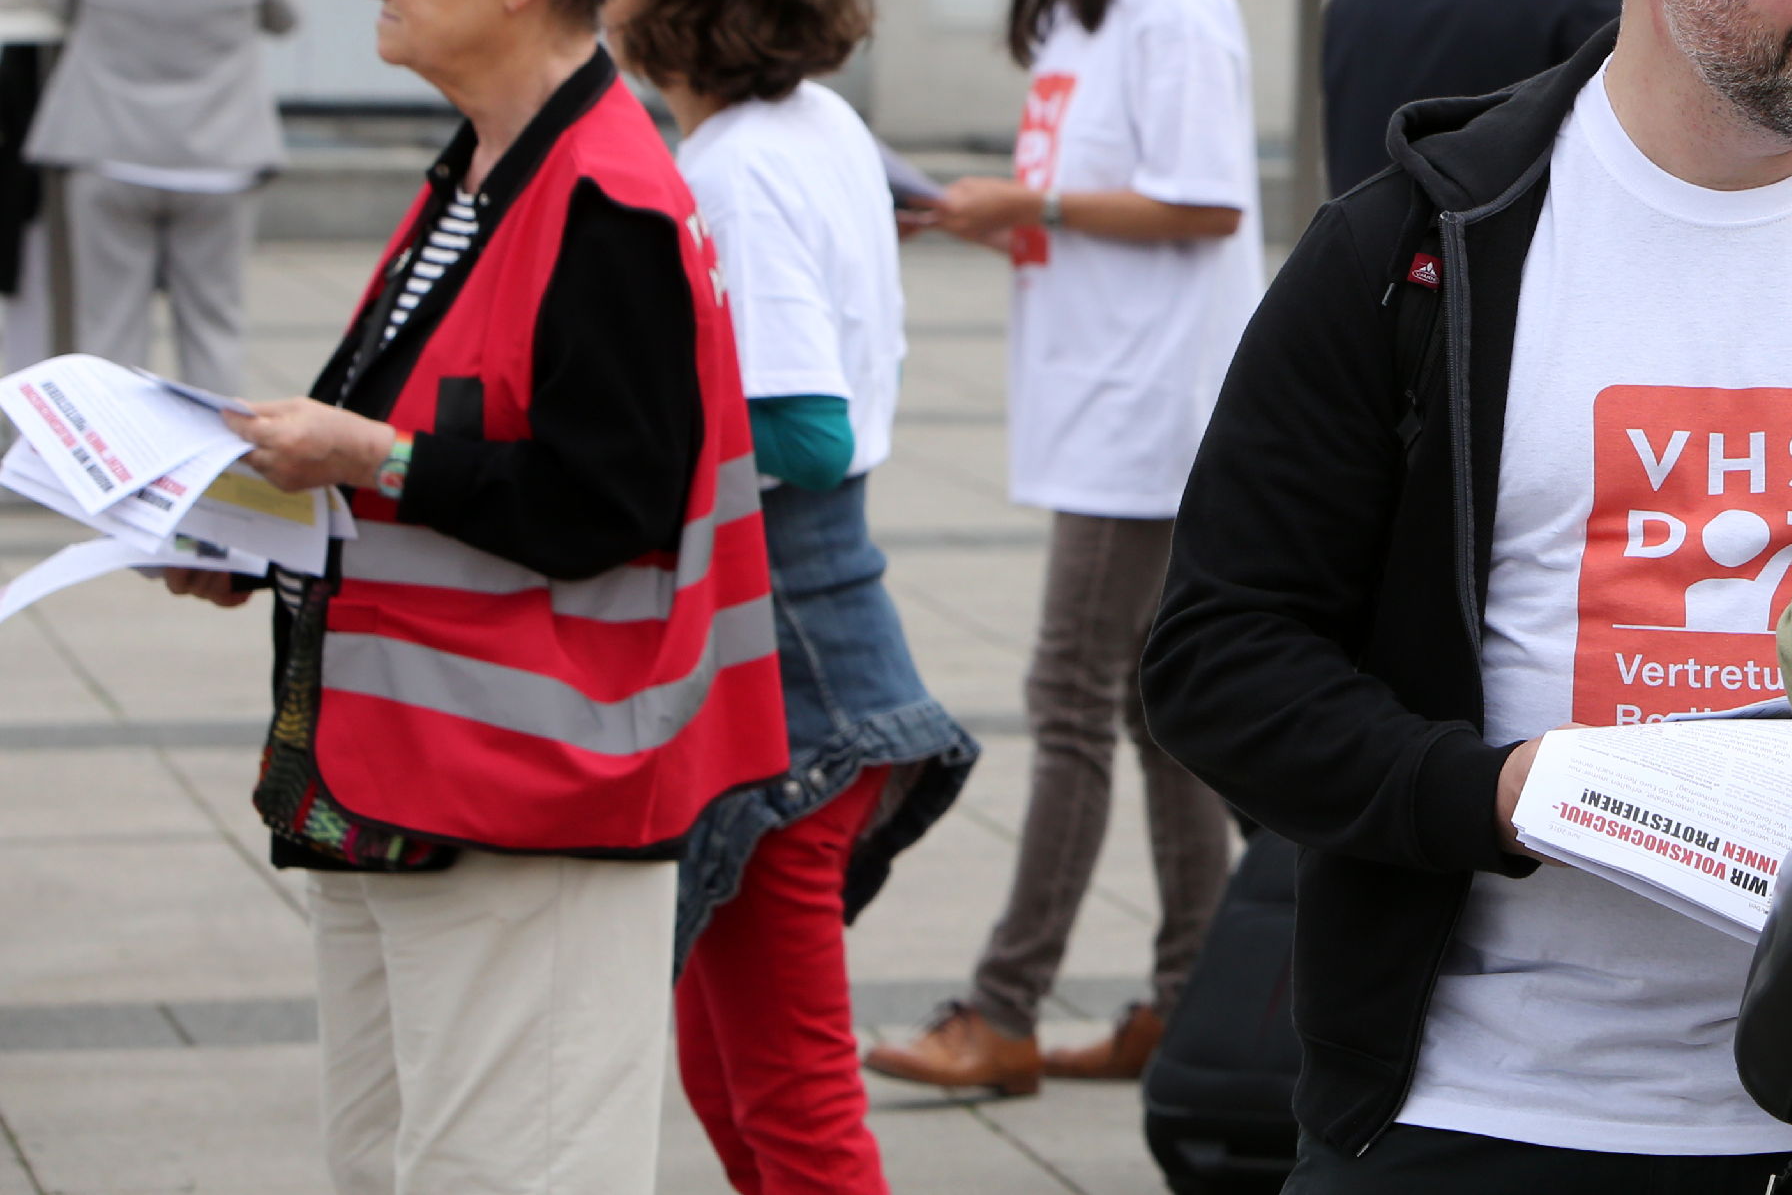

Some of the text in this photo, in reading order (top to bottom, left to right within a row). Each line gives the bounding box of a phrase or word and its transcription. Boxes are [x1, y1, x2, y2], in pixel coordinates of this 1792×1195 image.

[1551, 801, 1771, 898] WIR VOLKSHOCHSCHUL-
[1579, 787, 1720, 853] PROTESTIEREN!
